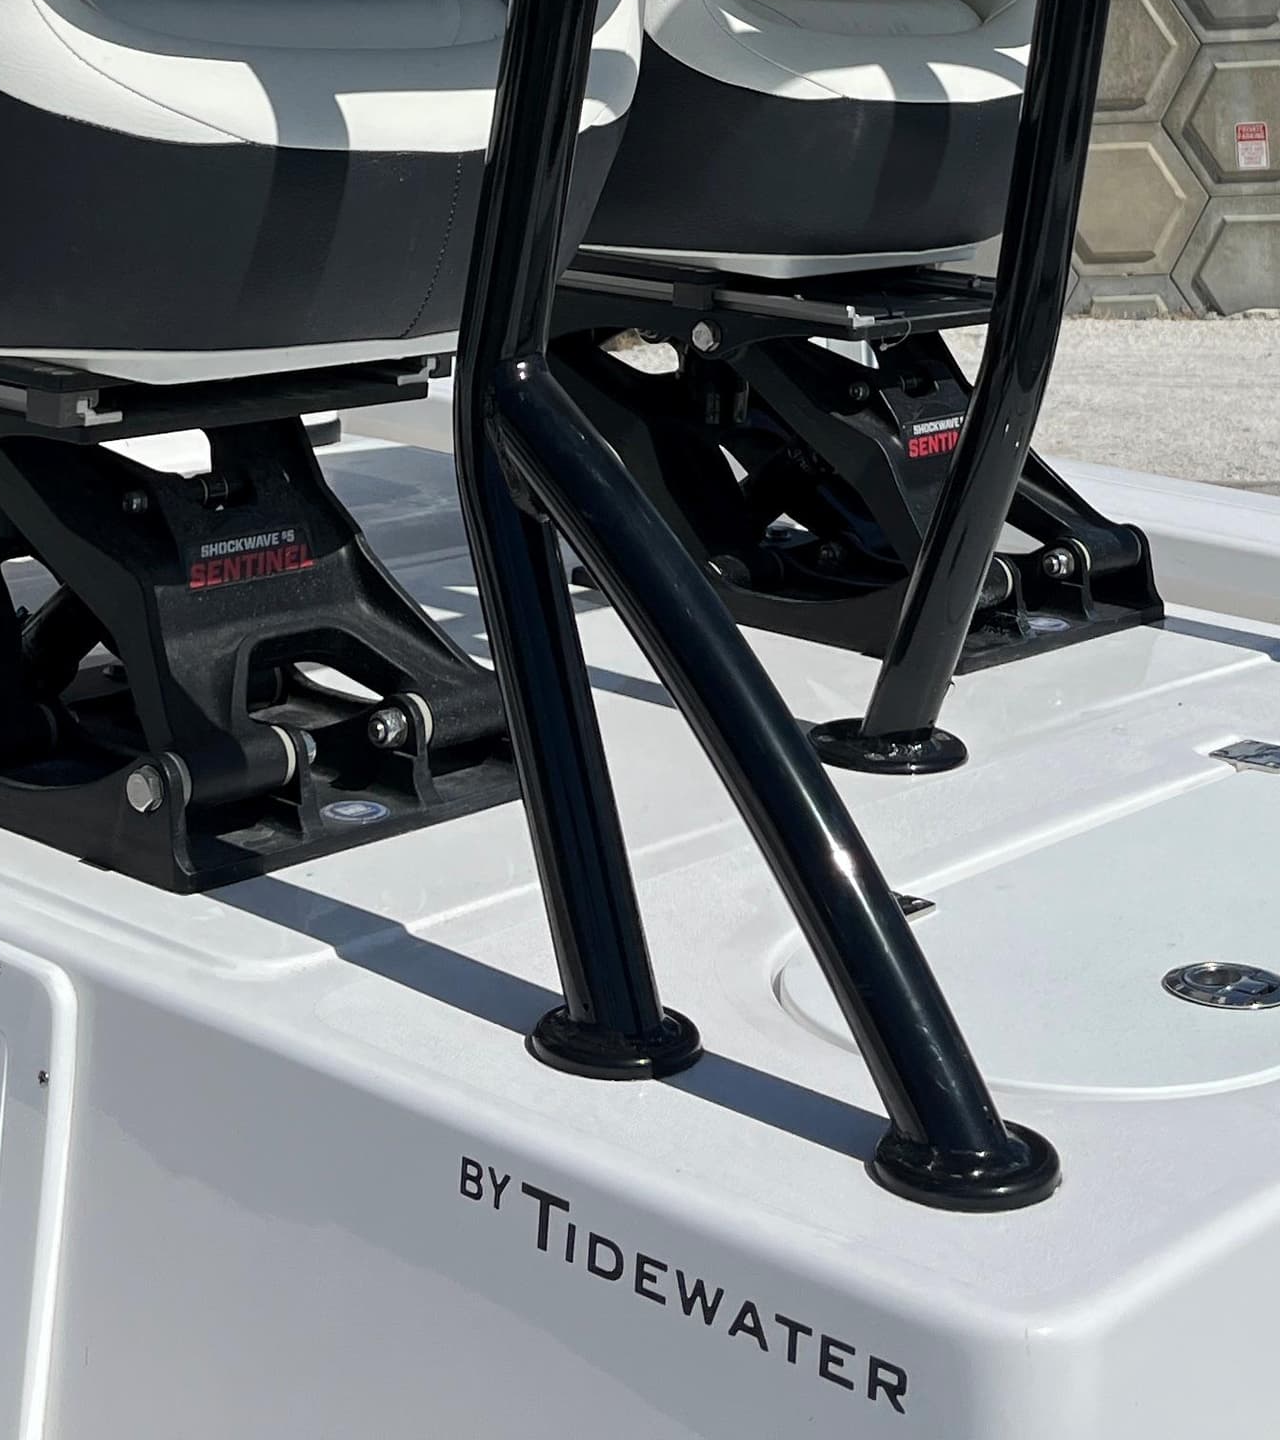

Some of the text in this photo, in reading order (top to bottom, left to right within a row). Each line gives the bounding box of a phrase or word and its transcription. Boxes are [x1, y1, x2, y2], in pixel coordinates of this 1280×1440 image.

[913, 416, 960, 436] SHOCKWAVE
[200, 531, 280, 558] SHOCKWAVE
[189, 543, 315, 590] SENTINEL
[459, 1155, 908, 1415] BY TIDEWATER
